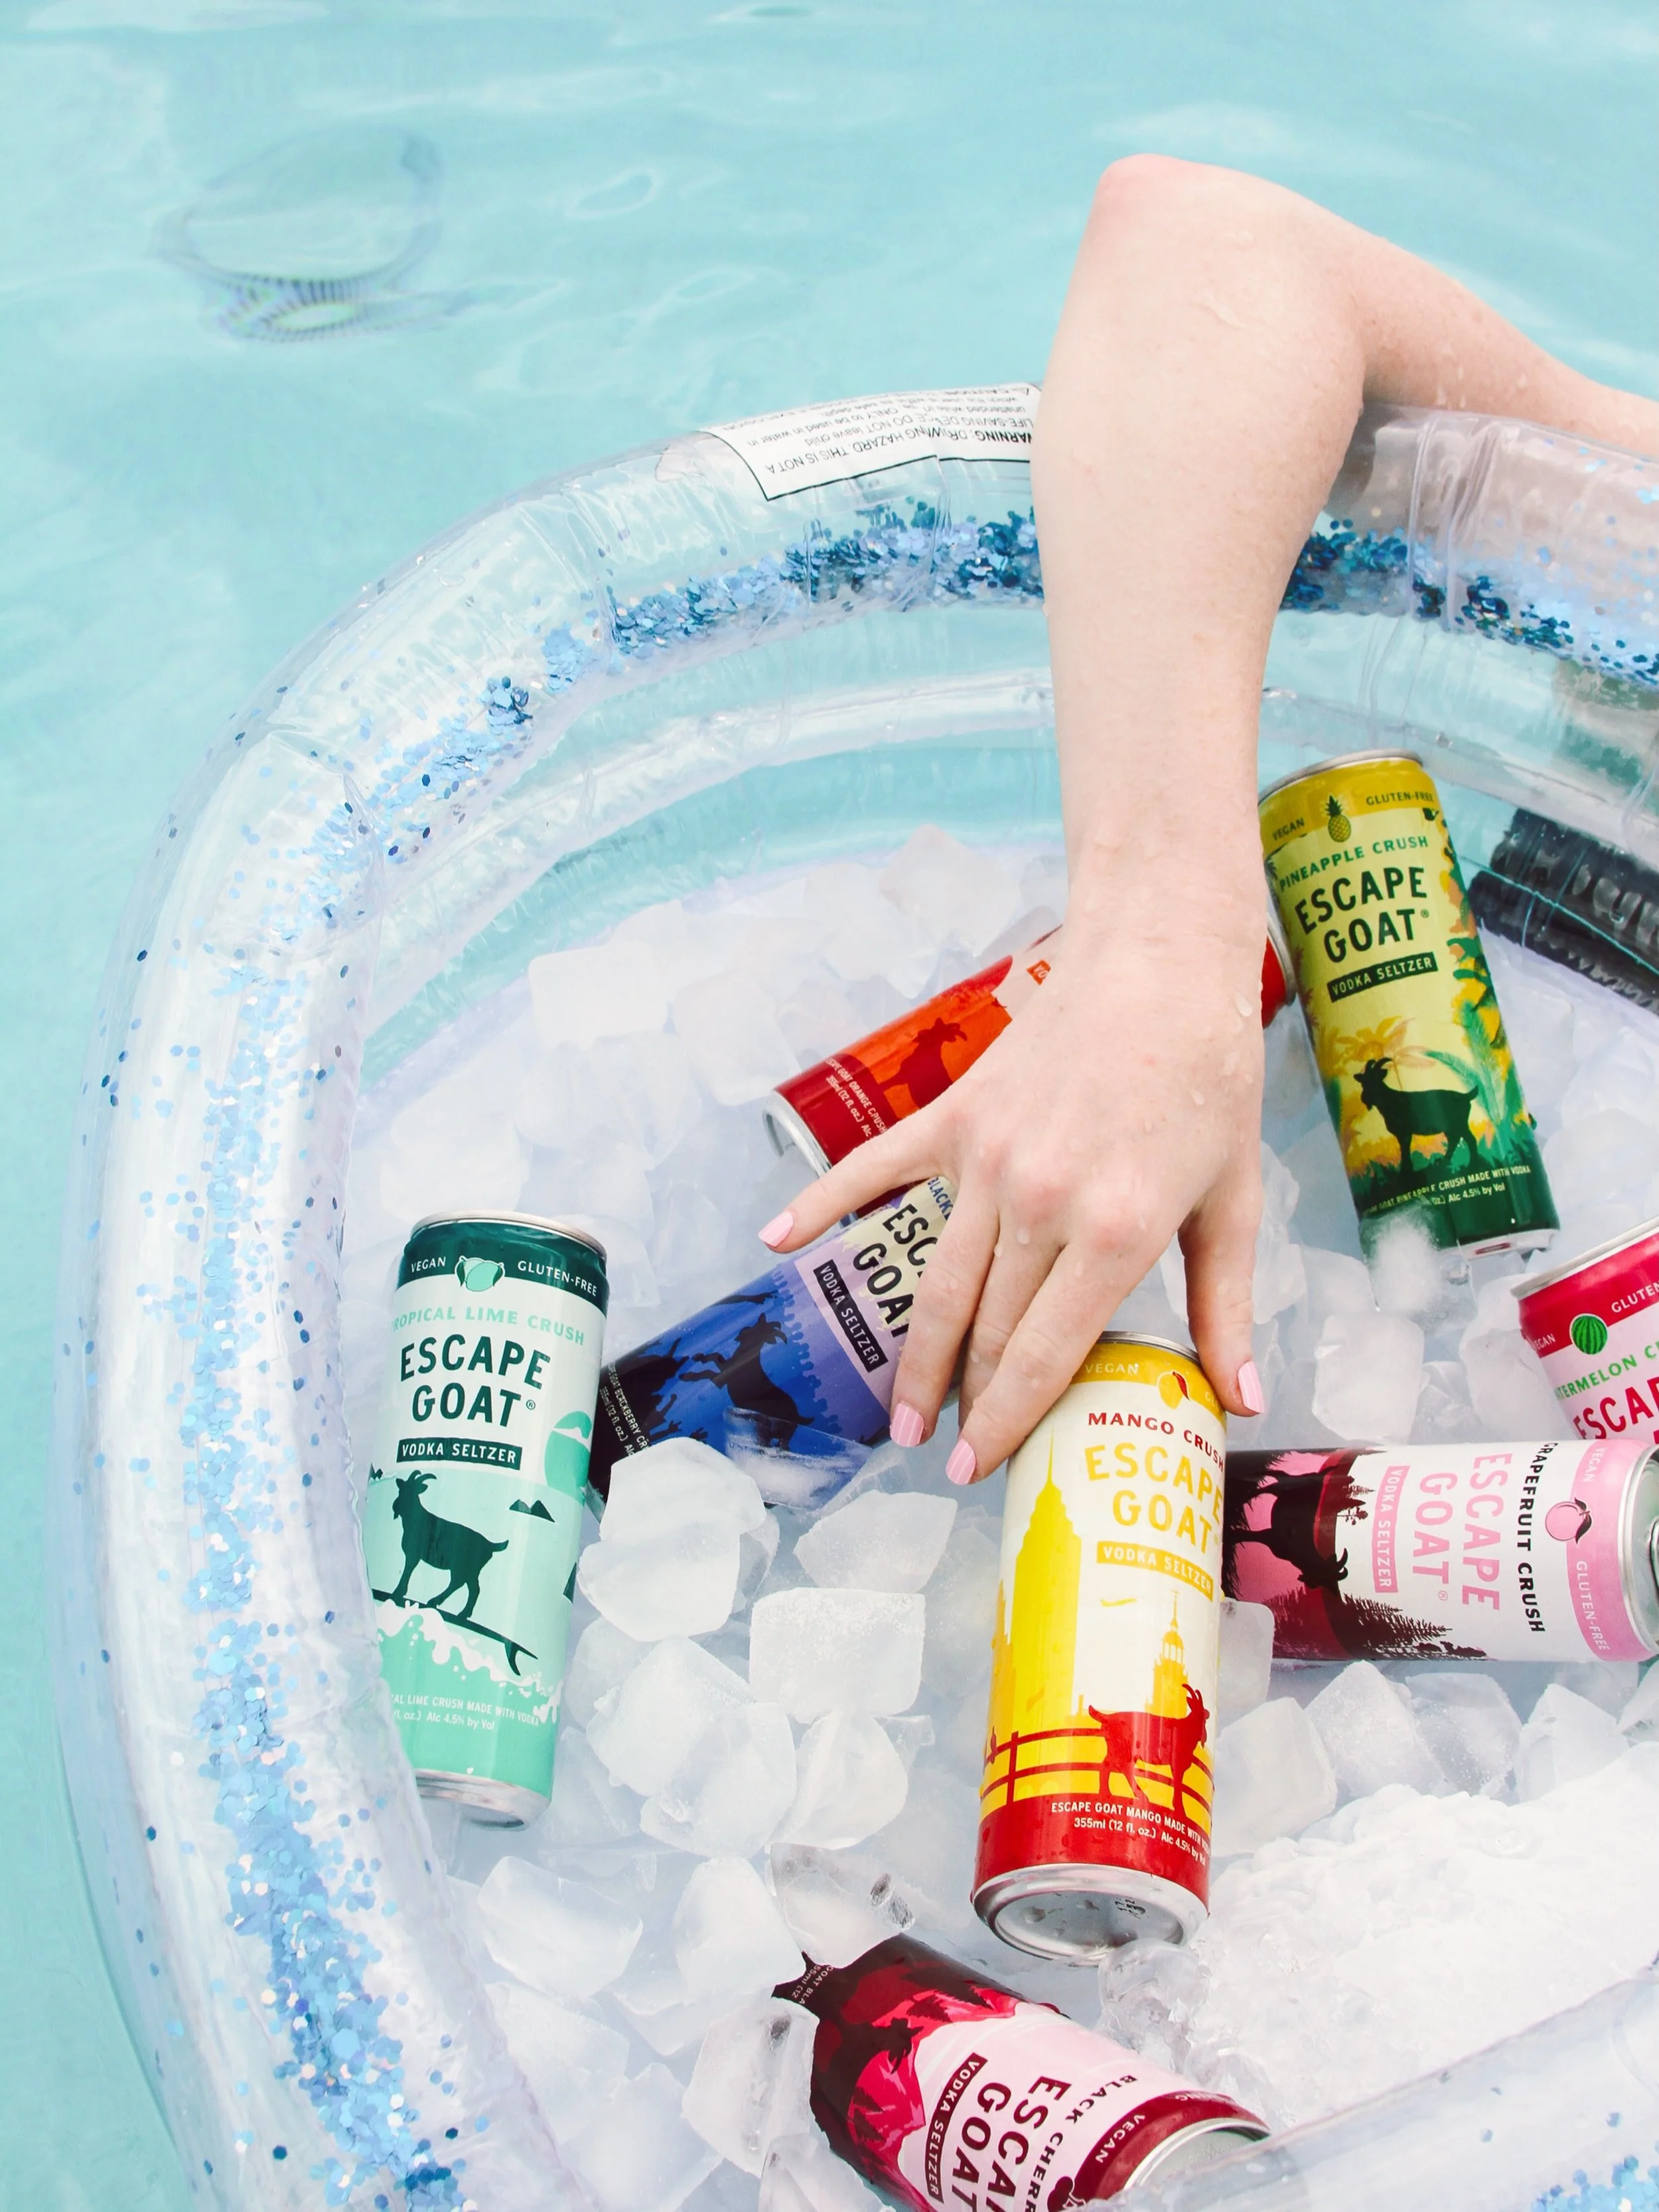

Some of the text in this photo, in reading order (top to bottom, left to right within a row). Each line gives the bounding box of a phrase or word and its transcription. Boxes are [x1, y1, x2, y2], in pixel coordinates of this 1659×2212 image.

[806, 421, 833, 433] used
[833, 426, 864, 438] leave
[865, 419, 892, 431] NOT
[867, 406, 899, 419] ONLY
[893, 414, 913, 426] DO
[747, 439, 759, 447] in
[762, 431, 792, 443] water
[805, 434, 830, 447] child
[805, 452, 819, 463] IS
[819, 447, 849, 461] THIS
[765, 464, 775, 475] A
[778, 456, 804, 473] NOT
[1272, 790, 1435, 841] VEGAN GLUTEN-FREE
[1279, 836, 1429, 892] PINEAPPLE CRUSH
[1293, 866, 1428, 936] ESCAPE
[1332, 956, 1433, 995] VODKA SELTZER
[867, 1107, 888, 1134] CRUSH
[1438, 1177, 1466, 1191] CRUSH
[1467, 1171, 1490, 1184] MADE
[1491, 1167, 1510, 1179] WITH
[1448, 1193, 1461, 1203] Alc
[1463, 1188, 1481, 1199] 4.5%
[1482, 1186, 1492, 1195] by
[1493, 1182, 1506, 1192] Vol
[882, 1203, 938, 1278] ESC
[410, 1256, 597, 1297] VEGAN GLUTEN-FREE
[392, 1305, 585, 1346] ROPICAL LIME CRUSH
[820, 1265, 880, 1364] VODKA SELTZER
[400, 1333, 551, 1390] ESCAPE
[1084, 1362, 1139, 1376] VEGAN
[614, 1388, 642, 1435] BLACKBERRY
[401, 1439, 517, 1464] VODKA SELTZER
[1088, 1412, 1224, 1473] MANGO CRUSH
[1084, 1441, 1223, 1524] ESCAPE
[1376, 1469, 1404, 1587] VODKA SELTZER
[1462, 1453, 1513, 1611] ESCAPE
[1516, 1441, 1558, 1633] GRAPEFRUIT CRUSH
[1103, 1545, 1213, 1594] VODKA SELTZER
[1576, 1447, 1611, 1651] VEGAN GLUTEN-FREE
[407, 1694, 429, 1706] LIME
[432, 1696, 464, 1710] CRUSH
[466, 1700, 492, 1715] MADE
[495, 1705, 516, 1720] WITH
[517, 1711, 540, 1728] VODKA
[426, 1711, 441, 1722] Alc
[443, 1713, 465, 1725] 4.5%
[467, 1716, 479, 1730] by
[482, 1720, 495, 1730] Vol
[1051, 1801, 1091, 1812] ESCAPE
[1095, 1802, 1123, 1815] GOAT
[1126, 1806, 1161, 1824] MANGO
[1164, 1816, 1186, 1834] MADE
[1187, 1826, 1201, 1844] WITH
[1074, 1817, 1106, 1828] 355ml
[1109, 1818, 1123, 1831] (12
[1138, 1826, 1157, 1839] oz.)
[1161, 1831, 1174, 1845] Alc
[1175, 1838, 1190, 1854] 4.5%
[1191, 1845, 1200, 1862] by
[1065, 2075, 1138, 2124] BLACK
[928, 2060, 980, 2195] VODKA SELTZER
[1095, 2114, 1145, 2163] VEGAN
